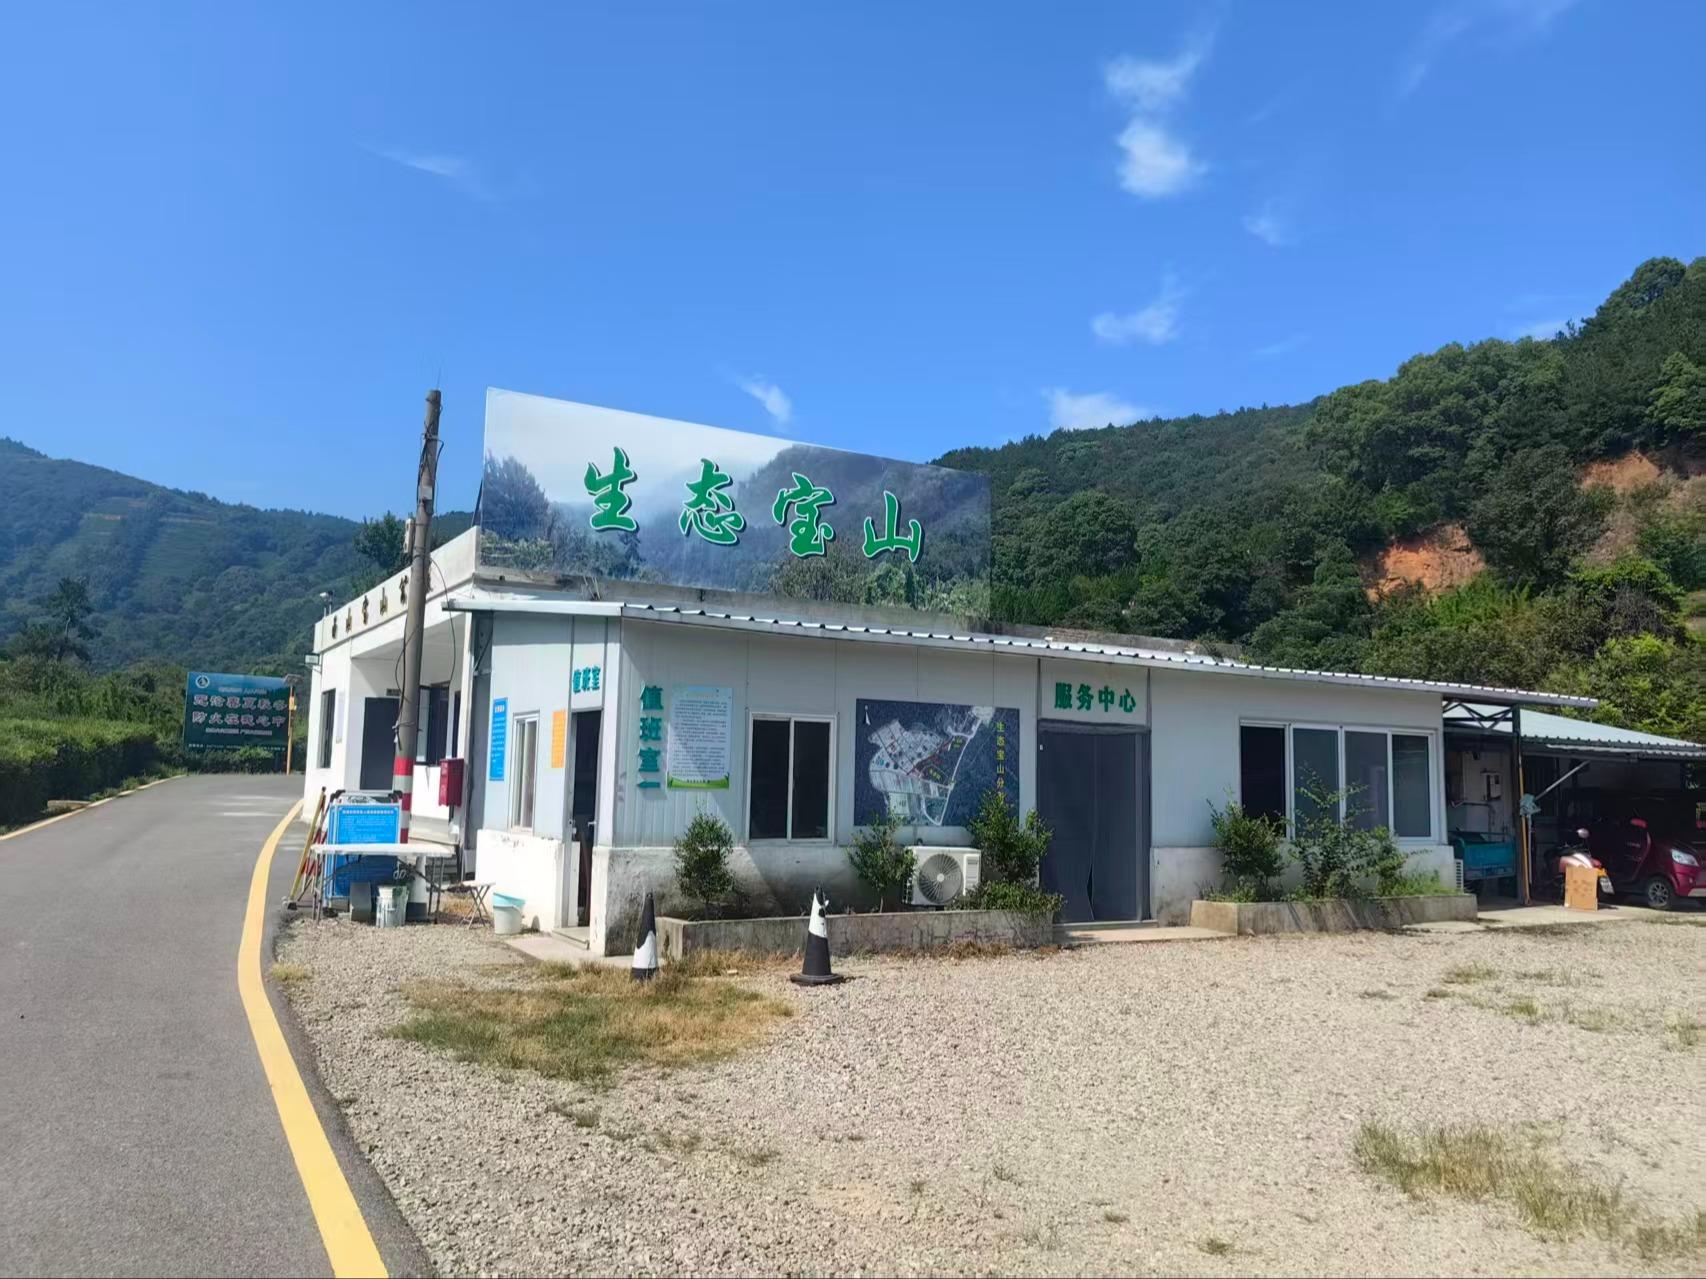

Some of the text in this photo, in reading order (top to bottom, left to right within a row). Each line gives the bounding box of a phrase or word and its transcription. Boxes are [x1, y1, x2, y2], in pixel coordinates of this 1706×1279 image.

[584, 446, 923, 562] 生态宝山
[1055, 682, 1136, 713] 服务中心
